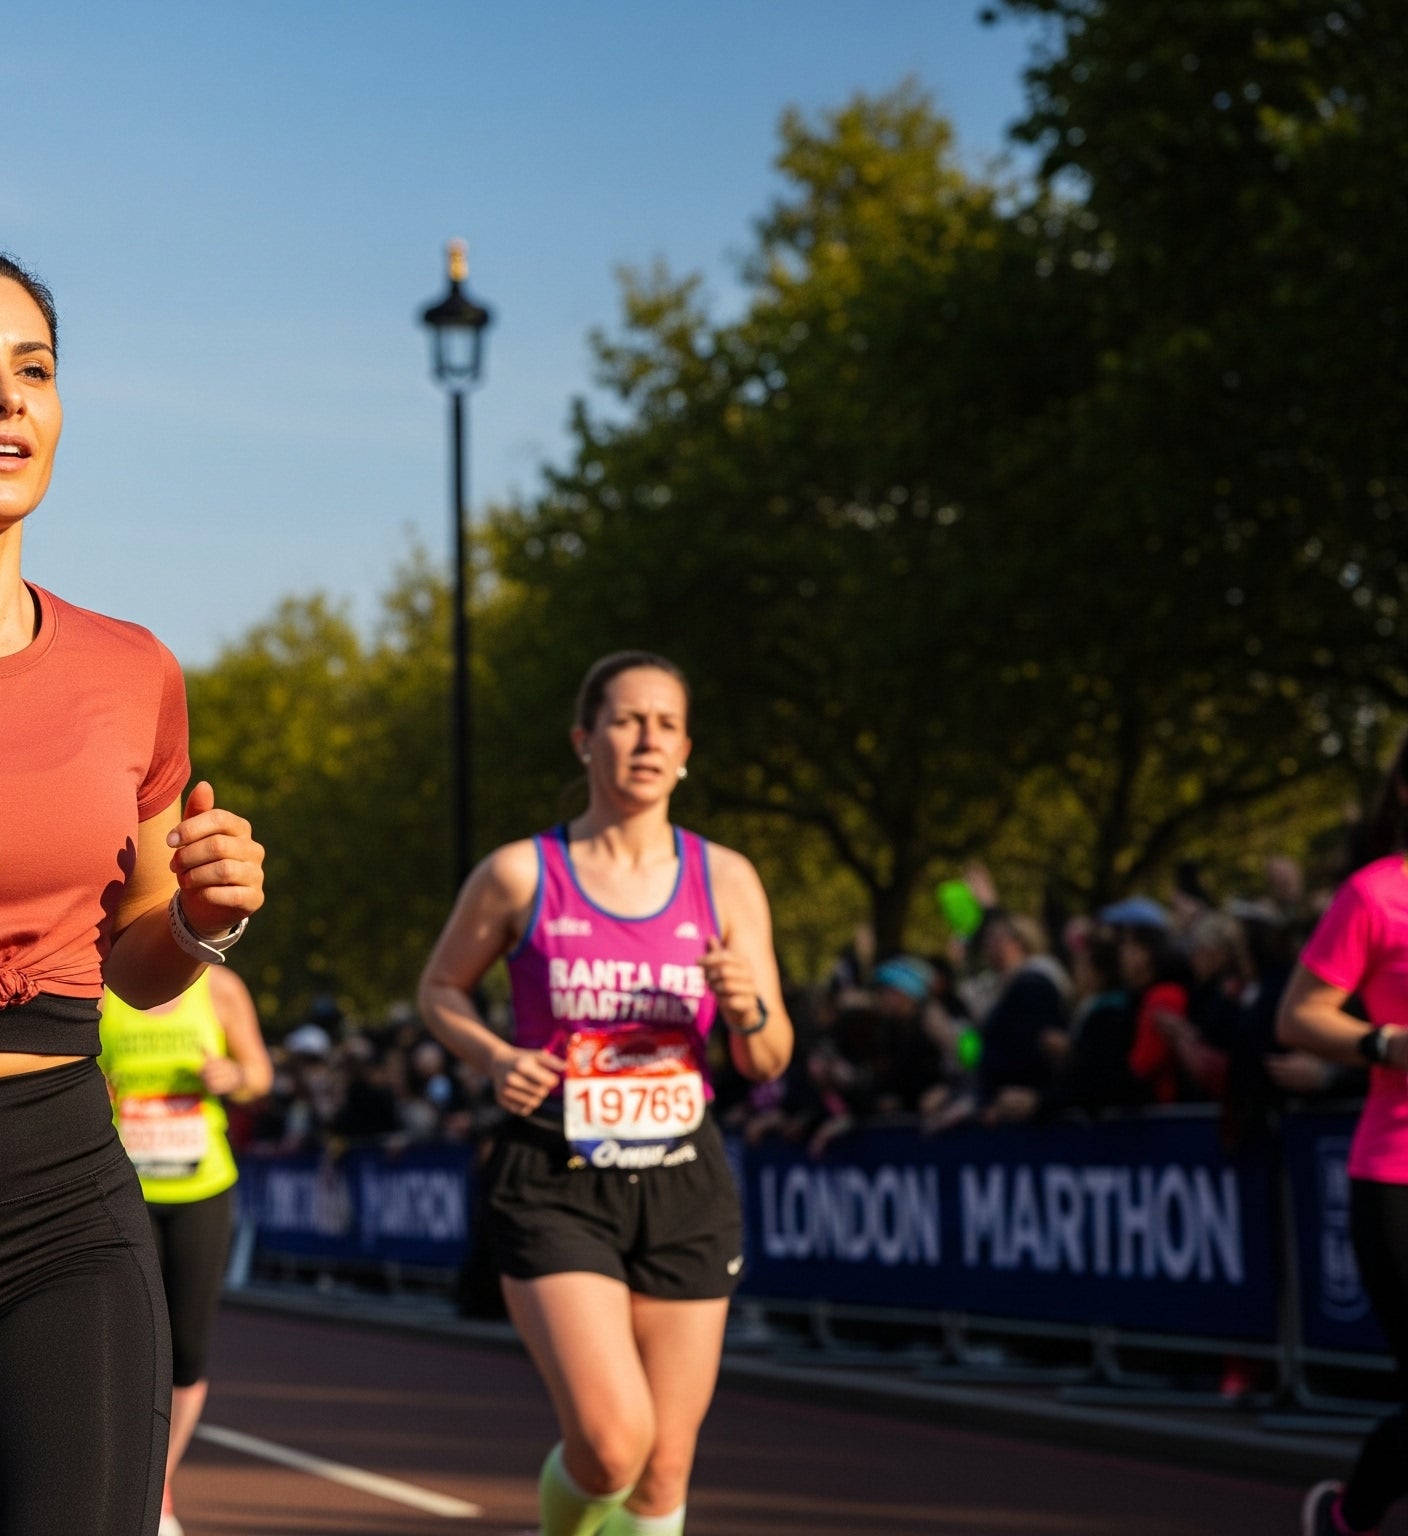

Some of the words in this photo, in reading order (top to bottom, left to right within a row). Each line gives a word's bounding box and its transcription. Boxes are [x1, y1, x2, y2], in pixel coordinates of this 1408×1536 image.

[576, 1085, 695, 1127] 19769
[759, 1165, 942, 1266] LONDON
[959, 1162, 1245, 1285] MARTHON
